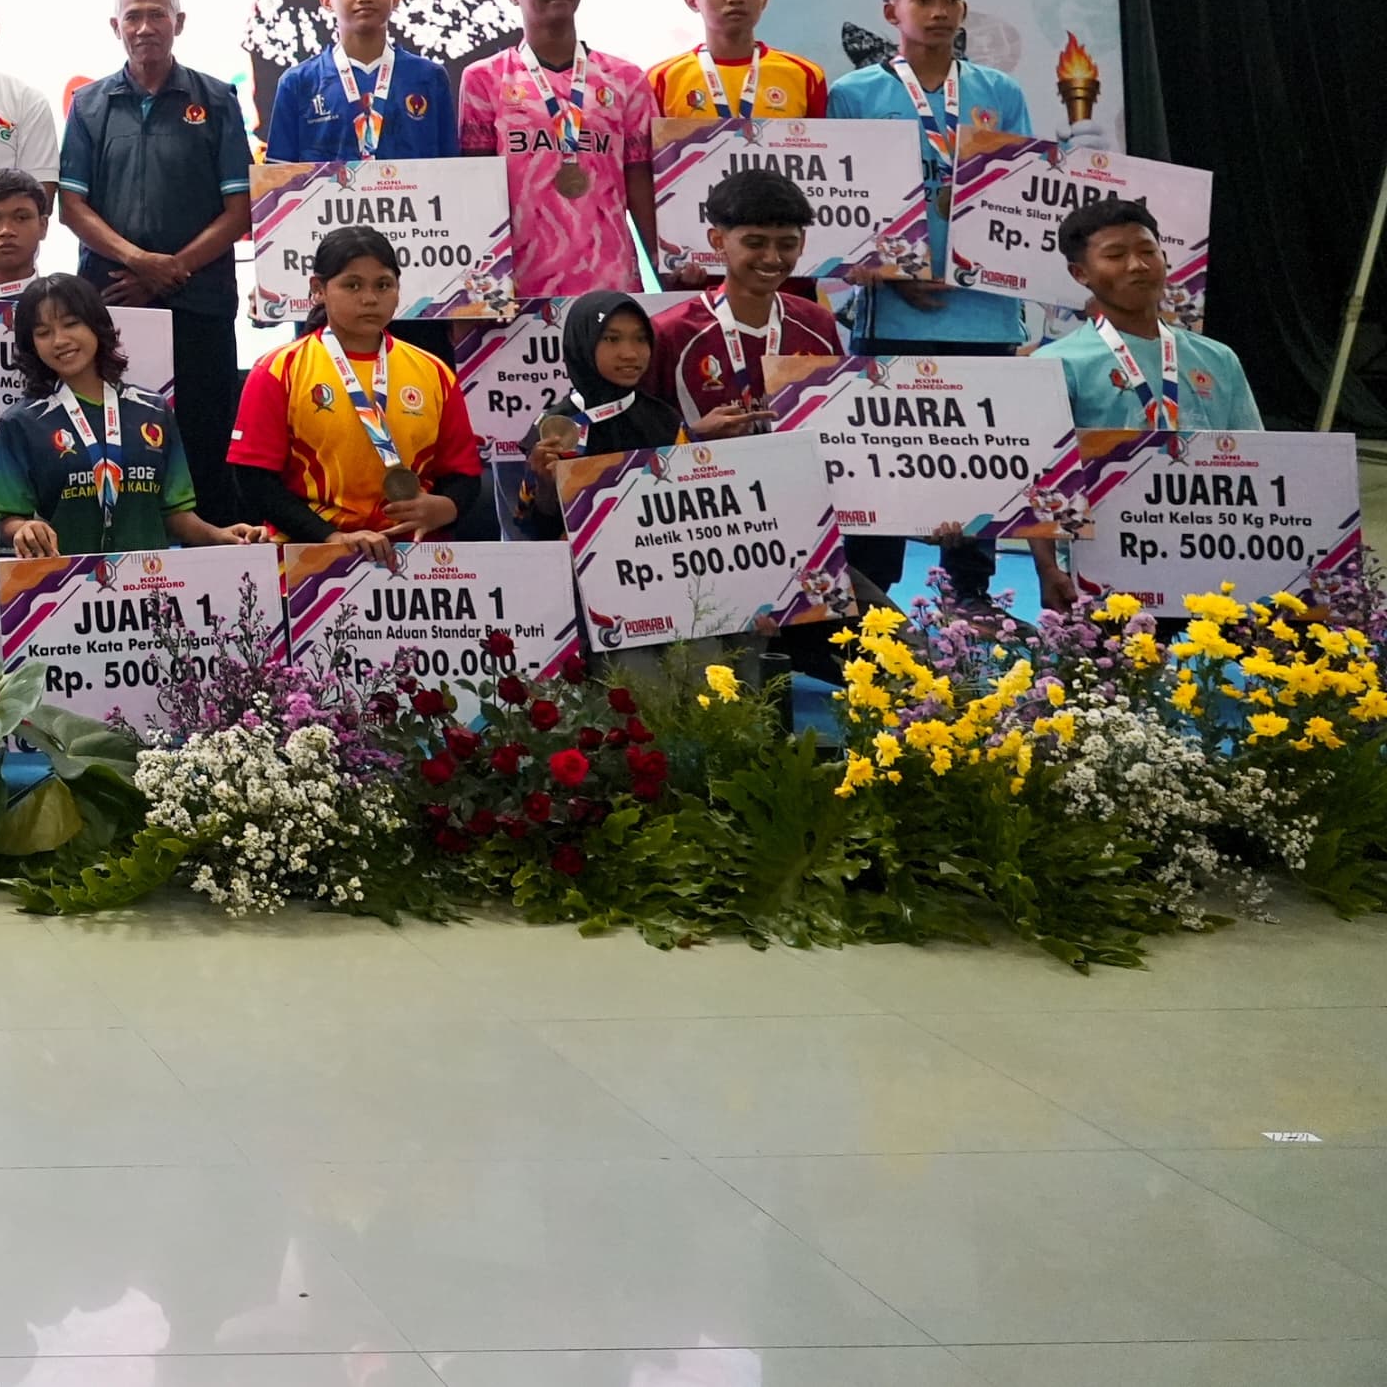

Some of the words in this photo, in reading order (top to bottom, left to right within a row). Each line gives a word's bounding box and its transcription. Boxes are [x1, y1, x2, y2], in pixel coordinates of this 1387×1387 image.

[318, 196, 417, 225] JUARA
[429, 196, 441, 221] 1
[981, 200, 1022, 216] Pencak
[1027, 208, 1051, 221] Silat
[498, 370, 547, 382] Beregu
[847, 397, 965, 427] JUARA
[977, 398, 995, 427] 1
[820, 433, 856, 445] Bola
[862, 434, 923, 448] Tangan
[929, 434, 979, 446] Beach
[985, 435, 1029, 447] Putra
[637, 484, 741, 527] JUARA
[749, 480, 766, 511] 1
[1145, 474, 1257, 506] JUARA
[1271, 476, 1286, 506] 1
[635, 533, 682, 548] Atletik
[687, 526, 722, 541] 1500
[727, 524, 741, 535] M
[744, 518, 778, 534] Putri
[1121, 511, 1163, 524] Gulat
[1169, 512, 1212, 525] Kelas
[1218, 513, 1236, 525] 50
[1243, 514, 1263, 527] Kg
[1270, 515, 1311, 527] Putra
[1120, 532, 1167, 565] Rp.
[1180, 534, 1327, 566] 500.000,-
[365, 588, 476, 621] JUARA
[489, 587, 503, 619] 1
[386, 626, 428, 639] Aduan
[432, 624, 480, 639] Standar
[515, 624, 544, 637] Putri
[28, 644, 81, 658] Karate
[87, 641, 123, 653] Kata
